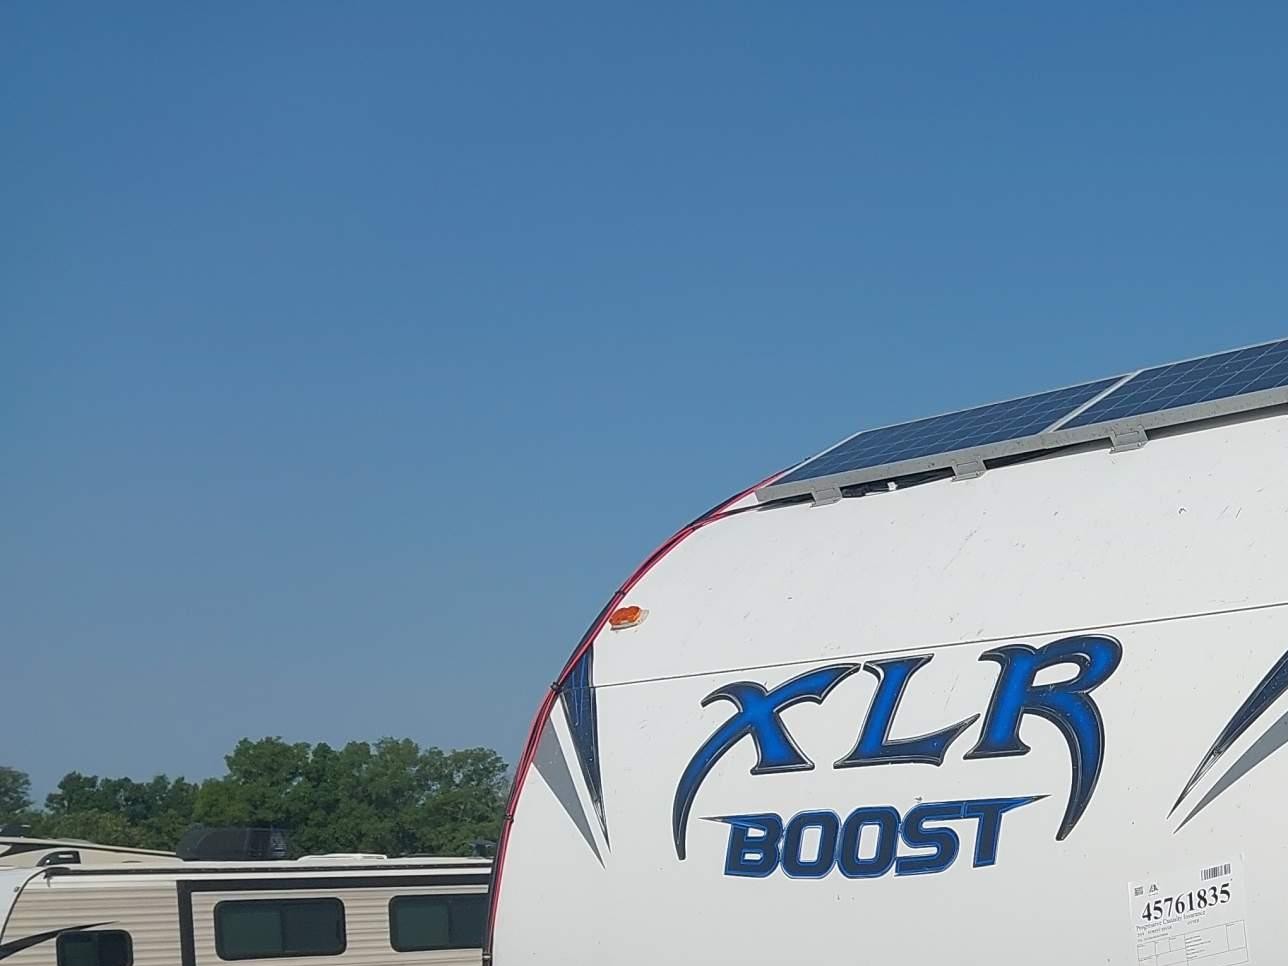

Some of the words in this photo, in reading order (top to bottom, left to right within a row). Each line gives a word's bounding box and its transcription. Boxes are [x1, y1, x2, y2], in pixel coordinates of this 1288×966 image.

[672, 633, 1123, 860] XLR
[699, 794, 1052, 880] BOOST
[1142, 882, 1231, 922] 45761835
